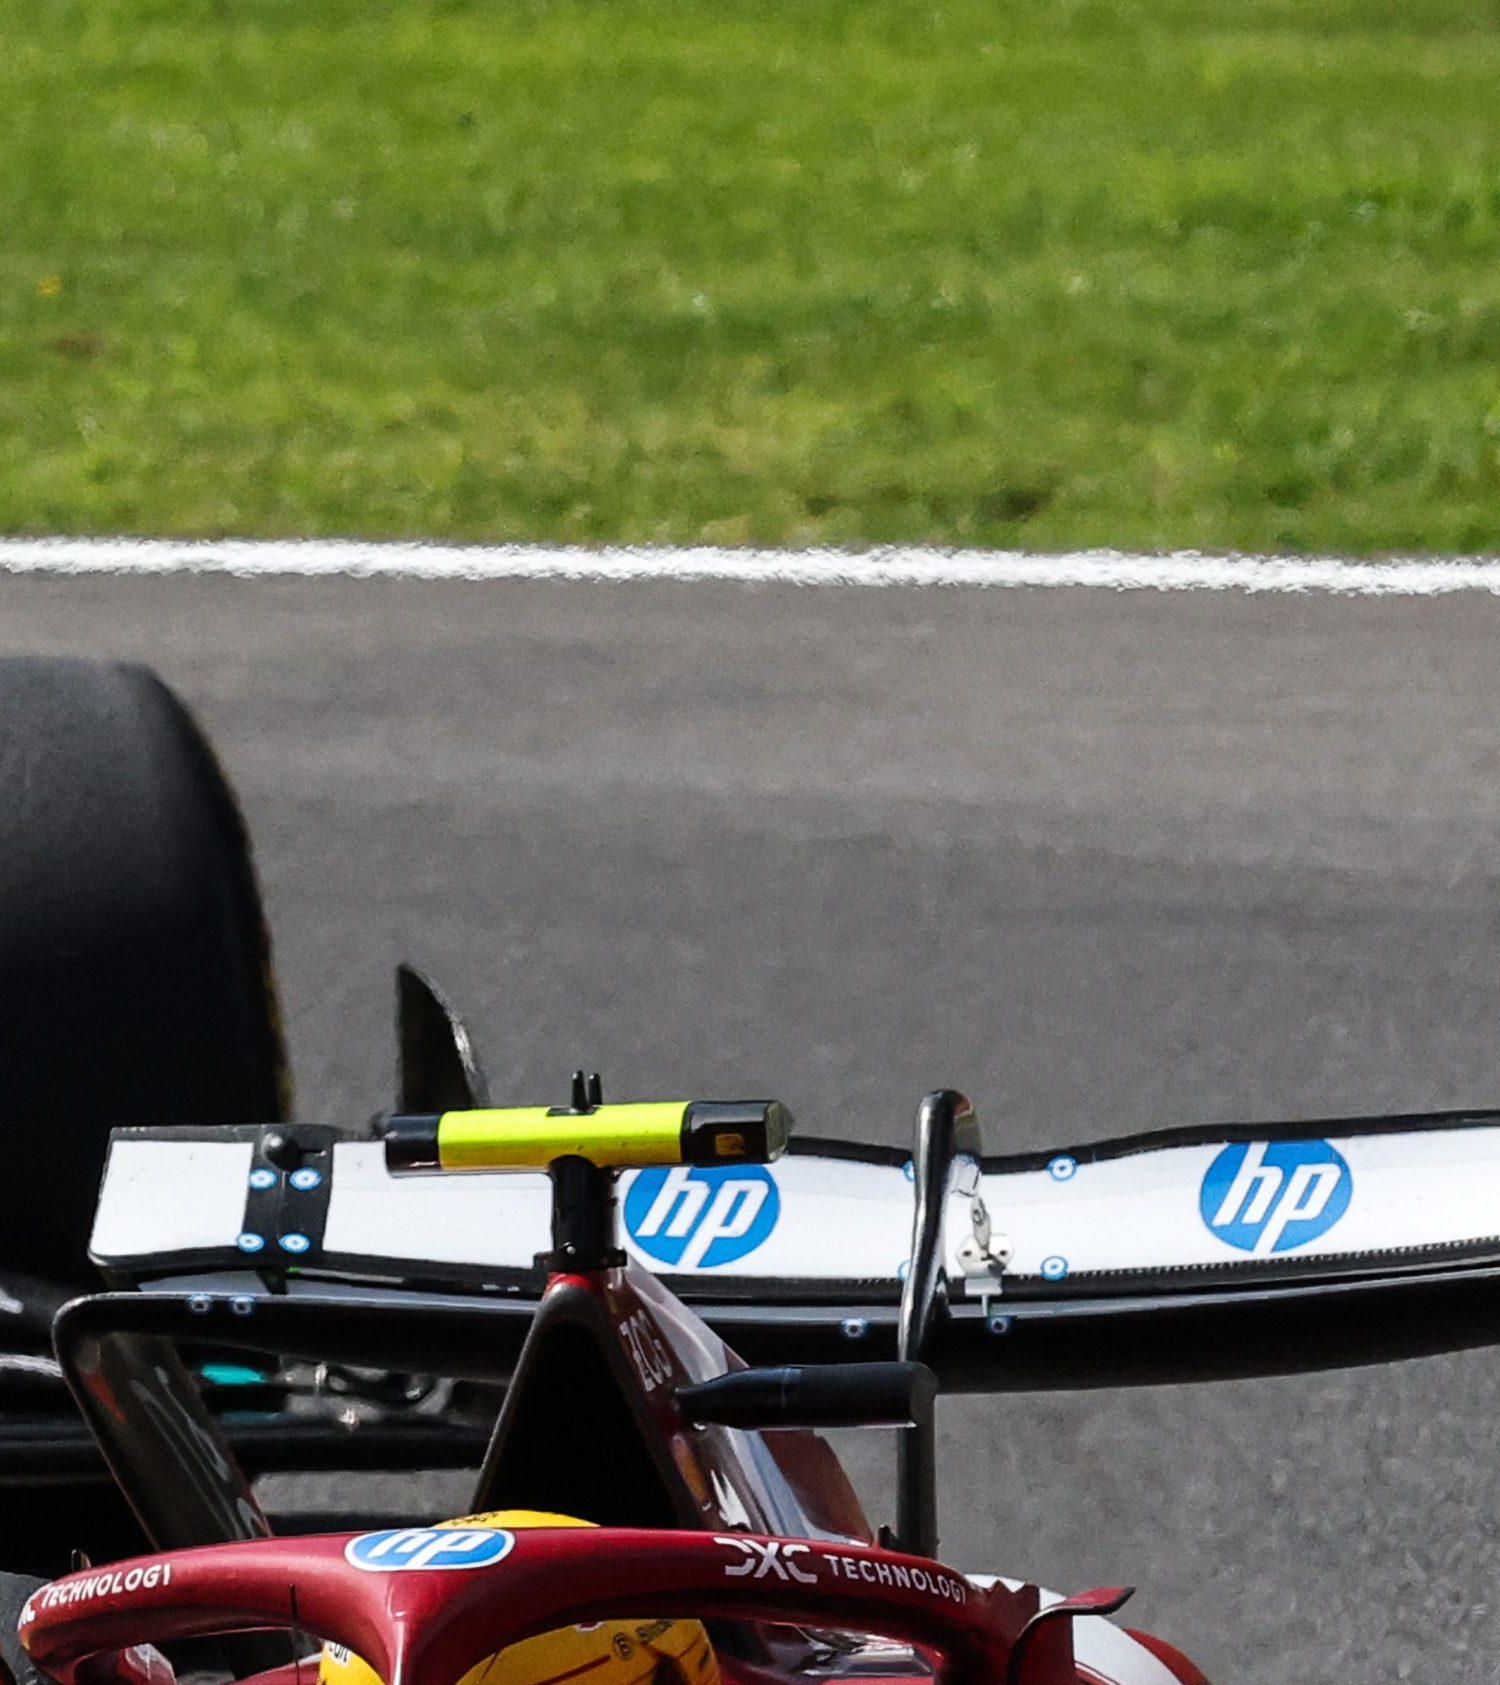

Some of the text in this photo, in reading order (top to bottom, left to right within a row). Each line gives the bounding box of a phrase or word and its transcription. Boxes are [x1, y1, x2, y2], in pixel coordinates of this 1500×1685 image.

[630, 1168, 774, 1268] hp
[1210, 1140, 1344, 1254] hp
[714, 1536, 819, 1584] DXC
